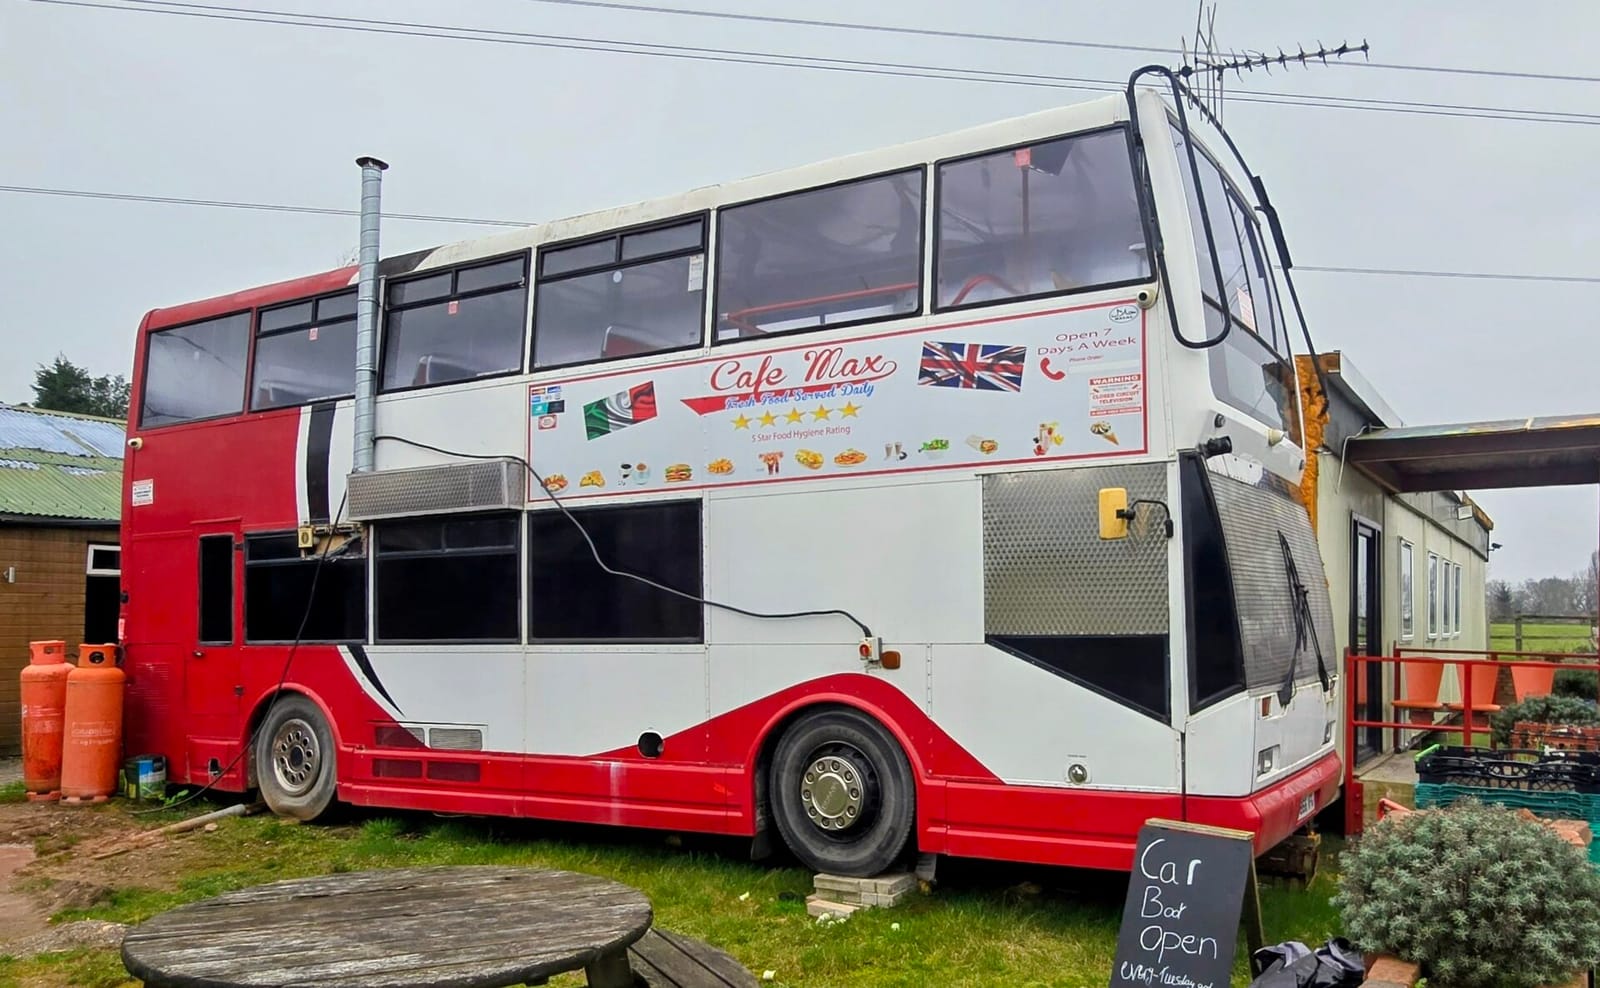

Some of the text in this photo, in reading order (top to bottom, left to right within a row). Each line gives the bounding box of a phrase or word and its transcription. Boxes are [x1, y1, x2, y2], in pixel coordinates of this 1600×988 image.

[1038, 337, 1137, 356] Days A Week
[1056, 328, 1112, 342] Open 7
[710, 347, 897, 398] Cafe Max
[1093, 375, 1139, 385] WARNING
[726, 382, 874, 410] Fresh Food Served Daily
[1092, 390, 1140, 400] CLOSED CIRCUIT
[751, 425, 851, 443] 5 Star Food Hygiene Rating
[1140, 838, 1202, 885] Car
[1141, 885, 1187, 920] Boot
[1140, 925, 1218, 964] Open
